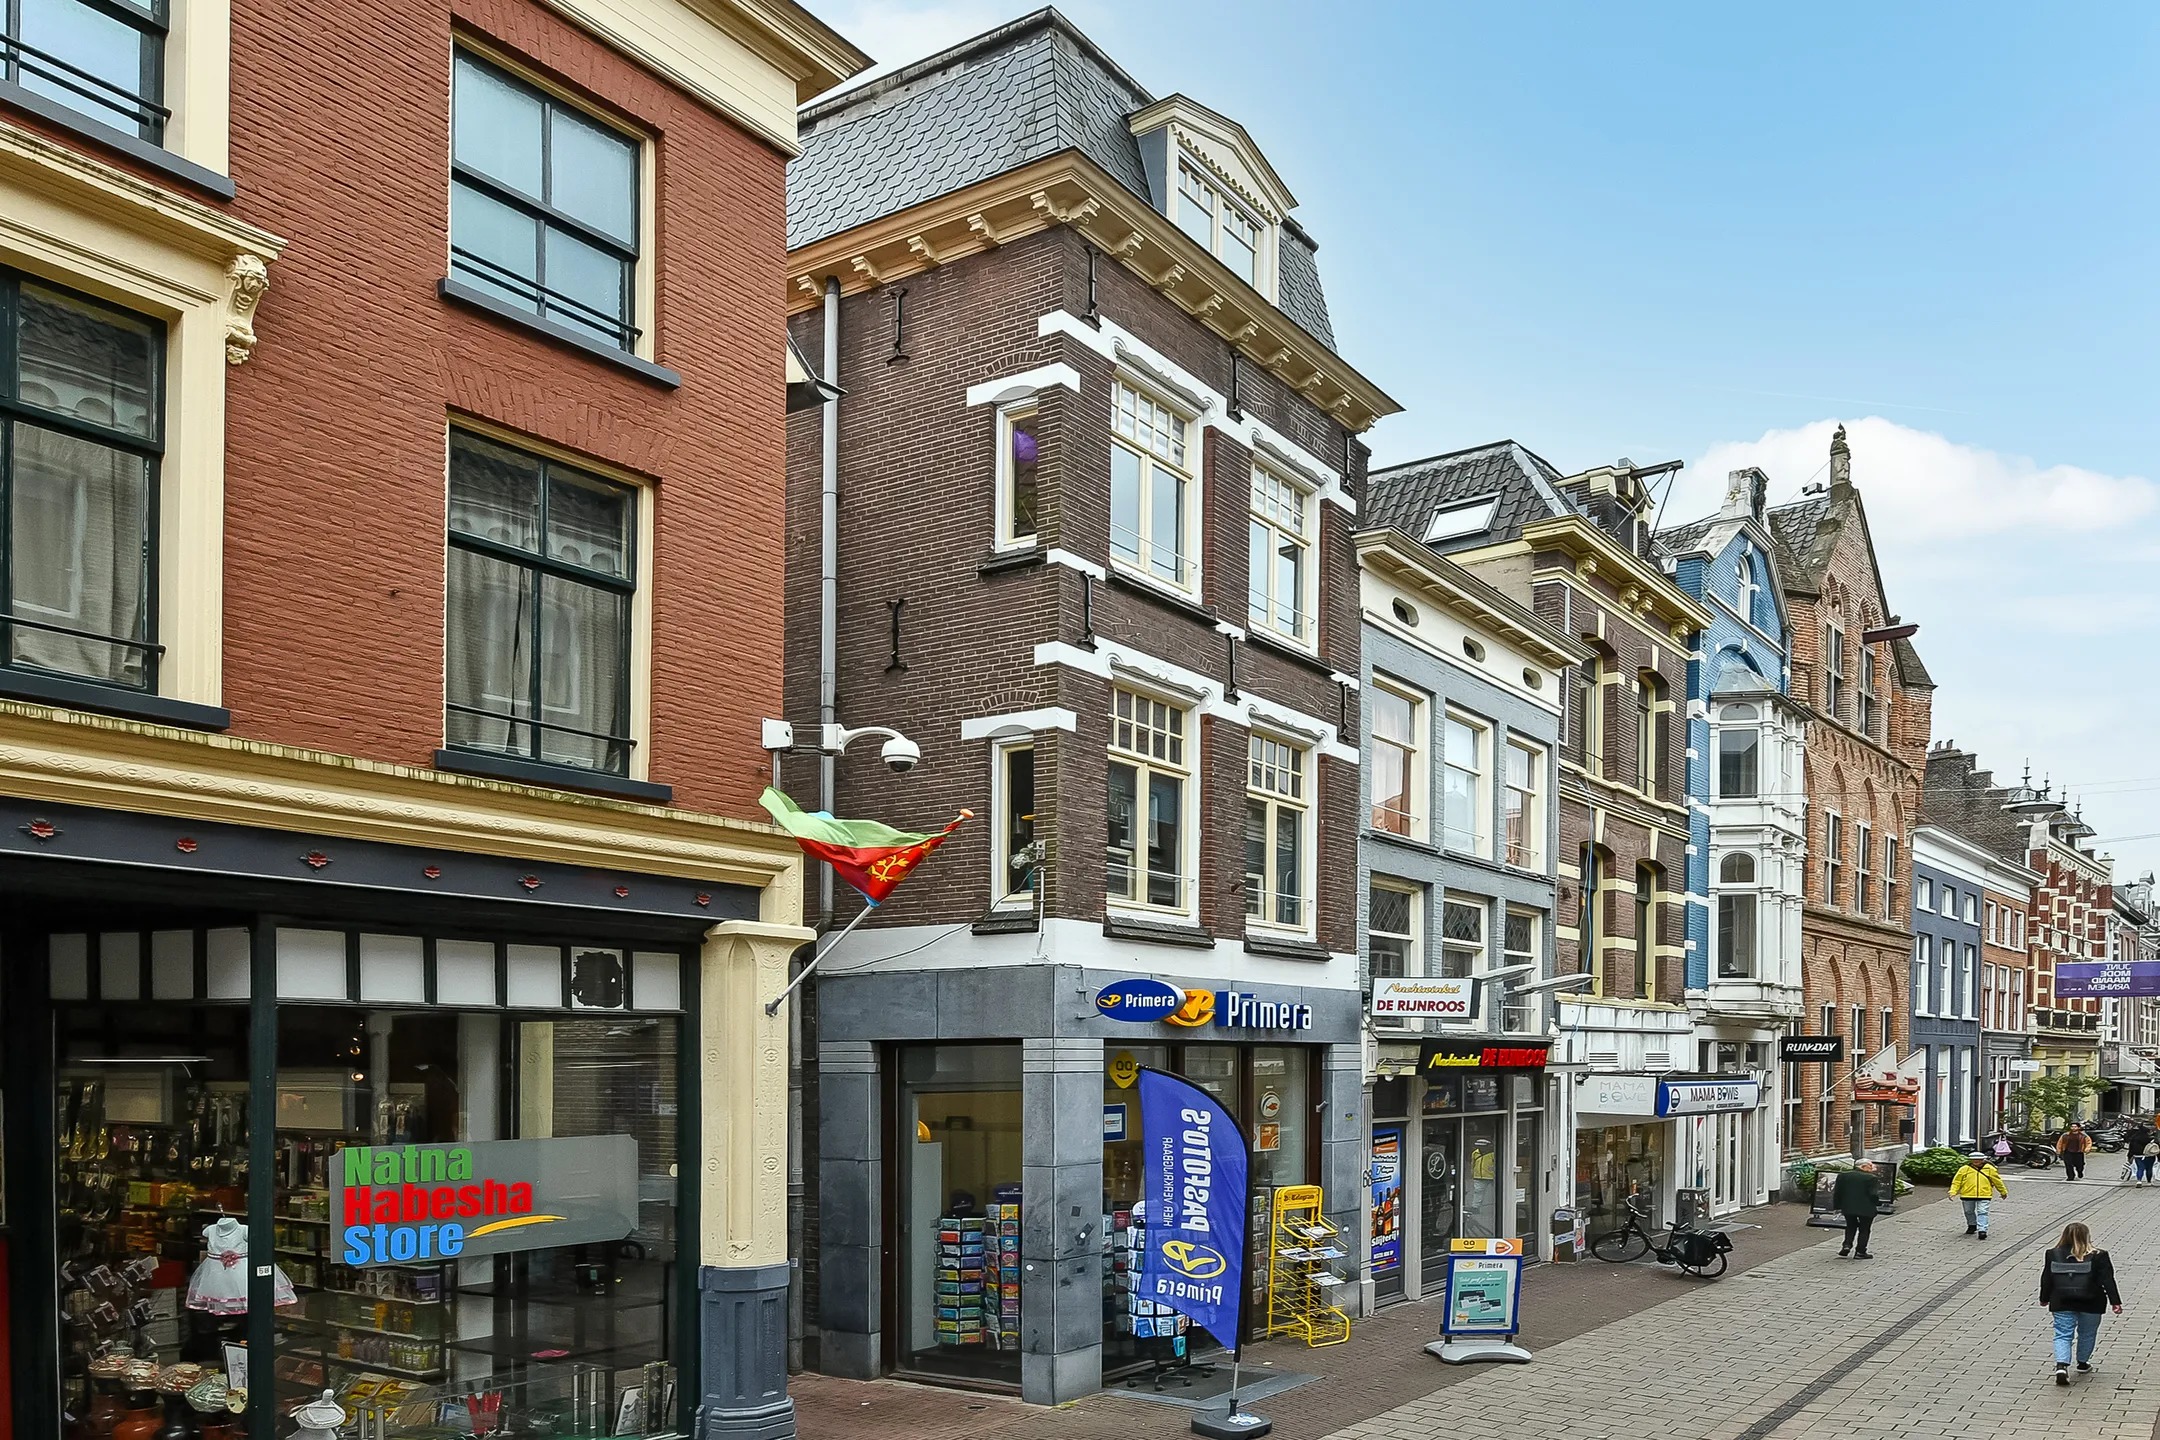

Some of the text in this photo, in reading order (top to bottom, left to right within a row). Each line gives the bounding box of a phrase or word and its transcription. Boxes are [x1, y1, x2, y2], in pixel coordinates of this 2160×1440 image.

[1125, 993, 1175, 1008] Primera
[1376, 1000, 1466, 1013] DE RIJNROOS
[1227, 991, 1313, 1030] Primera
[1481, 1048, 1497, 1067] DE
[1498, 1048, 1548, 1067] RIJNROOS
[1600, 1081, 1646, 1091] MAMA
[1690, 1087, 1716, 1102] MAMA
[343, 1144, 473, 1187] Natna
[343, 1178, 533, 1227] Habesha
[343, 1222, 464, 1266] Store
[1478, 1261, 1503, 1269] Primera
